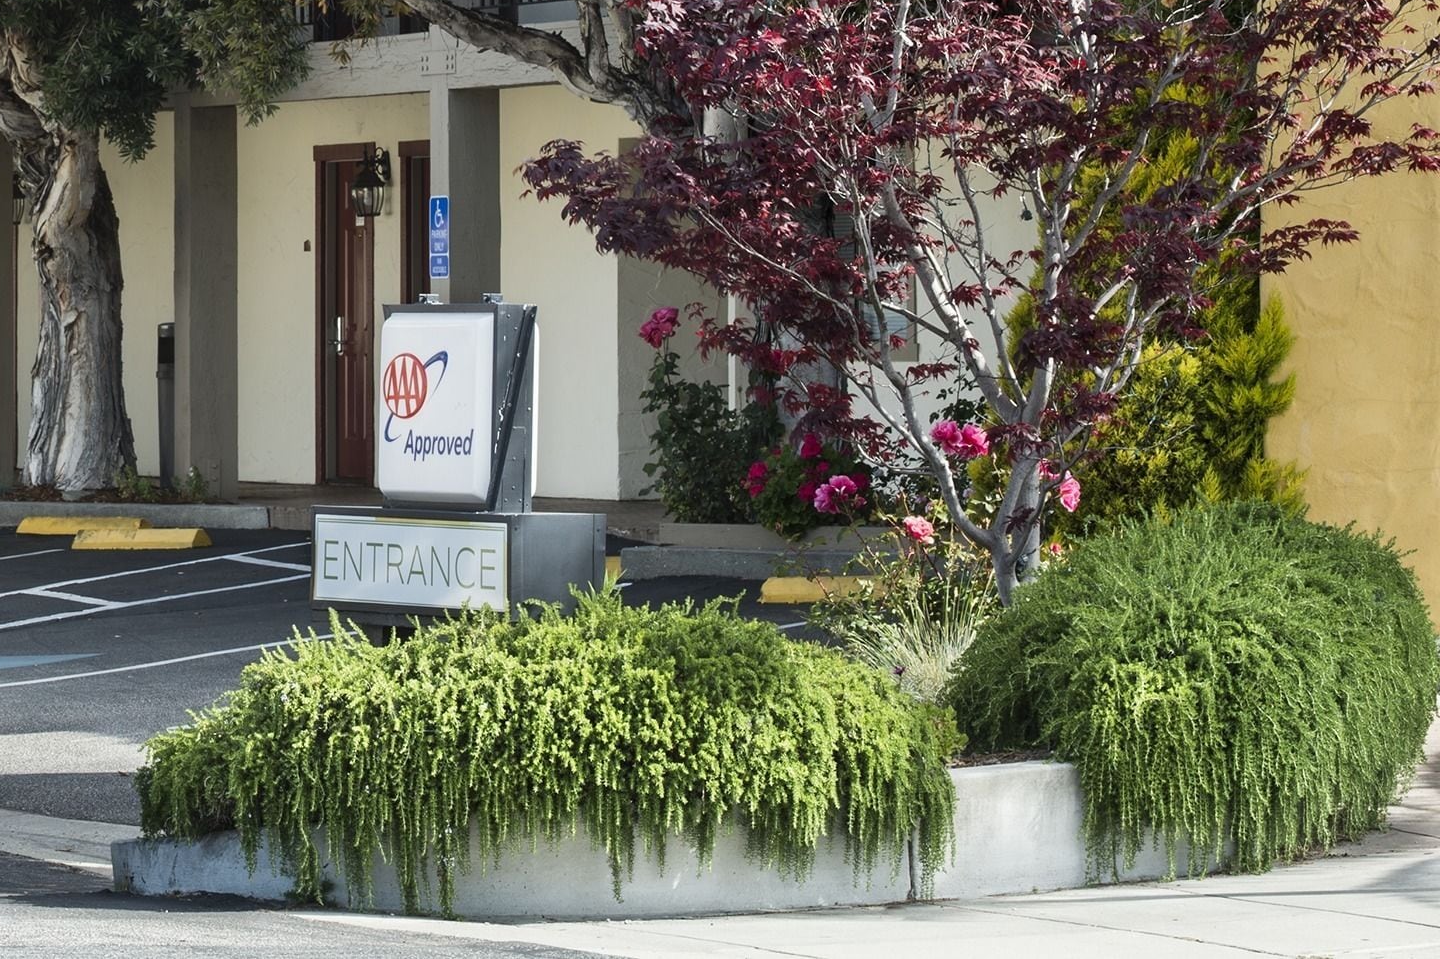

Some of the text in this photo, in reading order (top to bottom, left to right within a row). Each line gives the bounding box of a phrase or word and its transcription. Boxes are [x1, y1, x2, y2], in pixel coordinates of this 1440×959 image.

[385, 354, 424, 417] AAA
[403, 428, 474, 462] Approved
[323, 539, 496, 591] ENTRANCE
